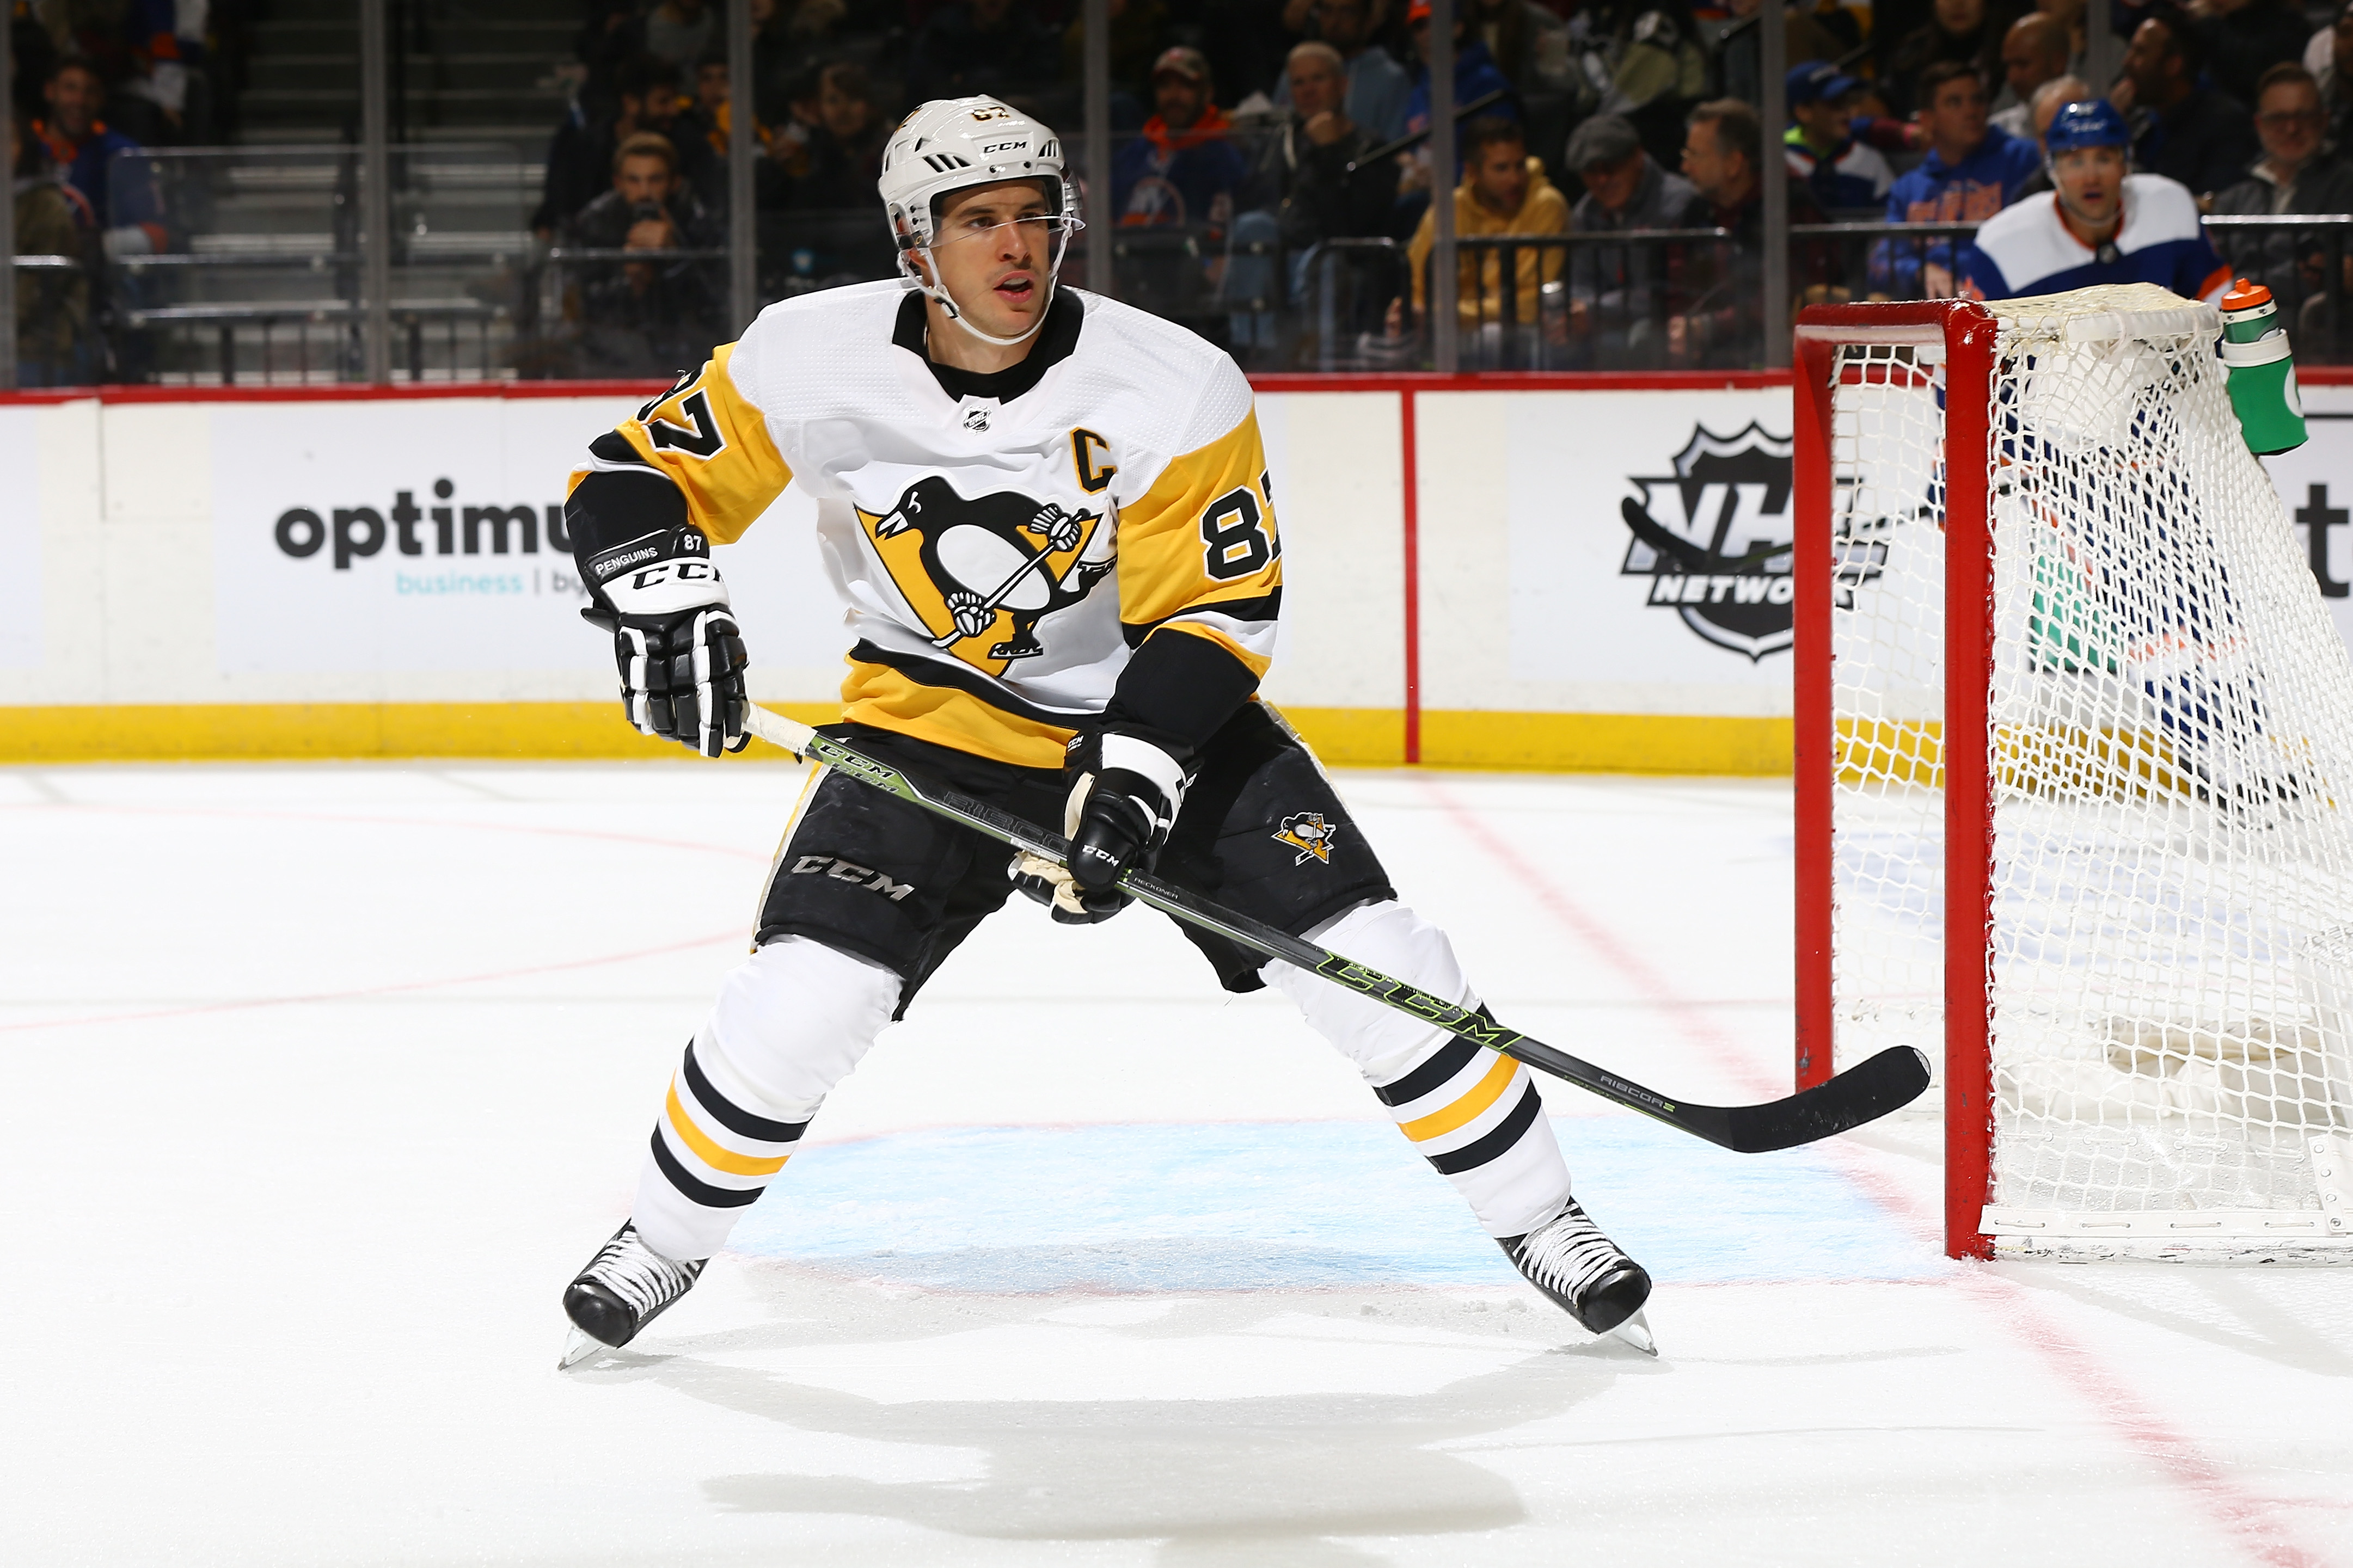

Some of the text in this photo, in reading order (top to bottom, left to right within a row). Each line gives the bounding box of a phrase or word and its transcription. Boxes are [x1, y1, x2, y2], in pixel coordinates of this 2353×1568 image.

[983, 140, 1028, 153] CCM
[1070, 426, 1117, 496] C
[683, 533, 703, 551] 87
[595, 546, 659, 576] PENGUINS
[396, 568, 523, 595] business
[818, 742, 896, 779] CCM
[1082, 844, 1119, 867] CCM
[791, 855, 915, 902] CCM
[1134, 877, 1179, 900] RECKONER
[1316, 949, 1525, 1050] CCM
